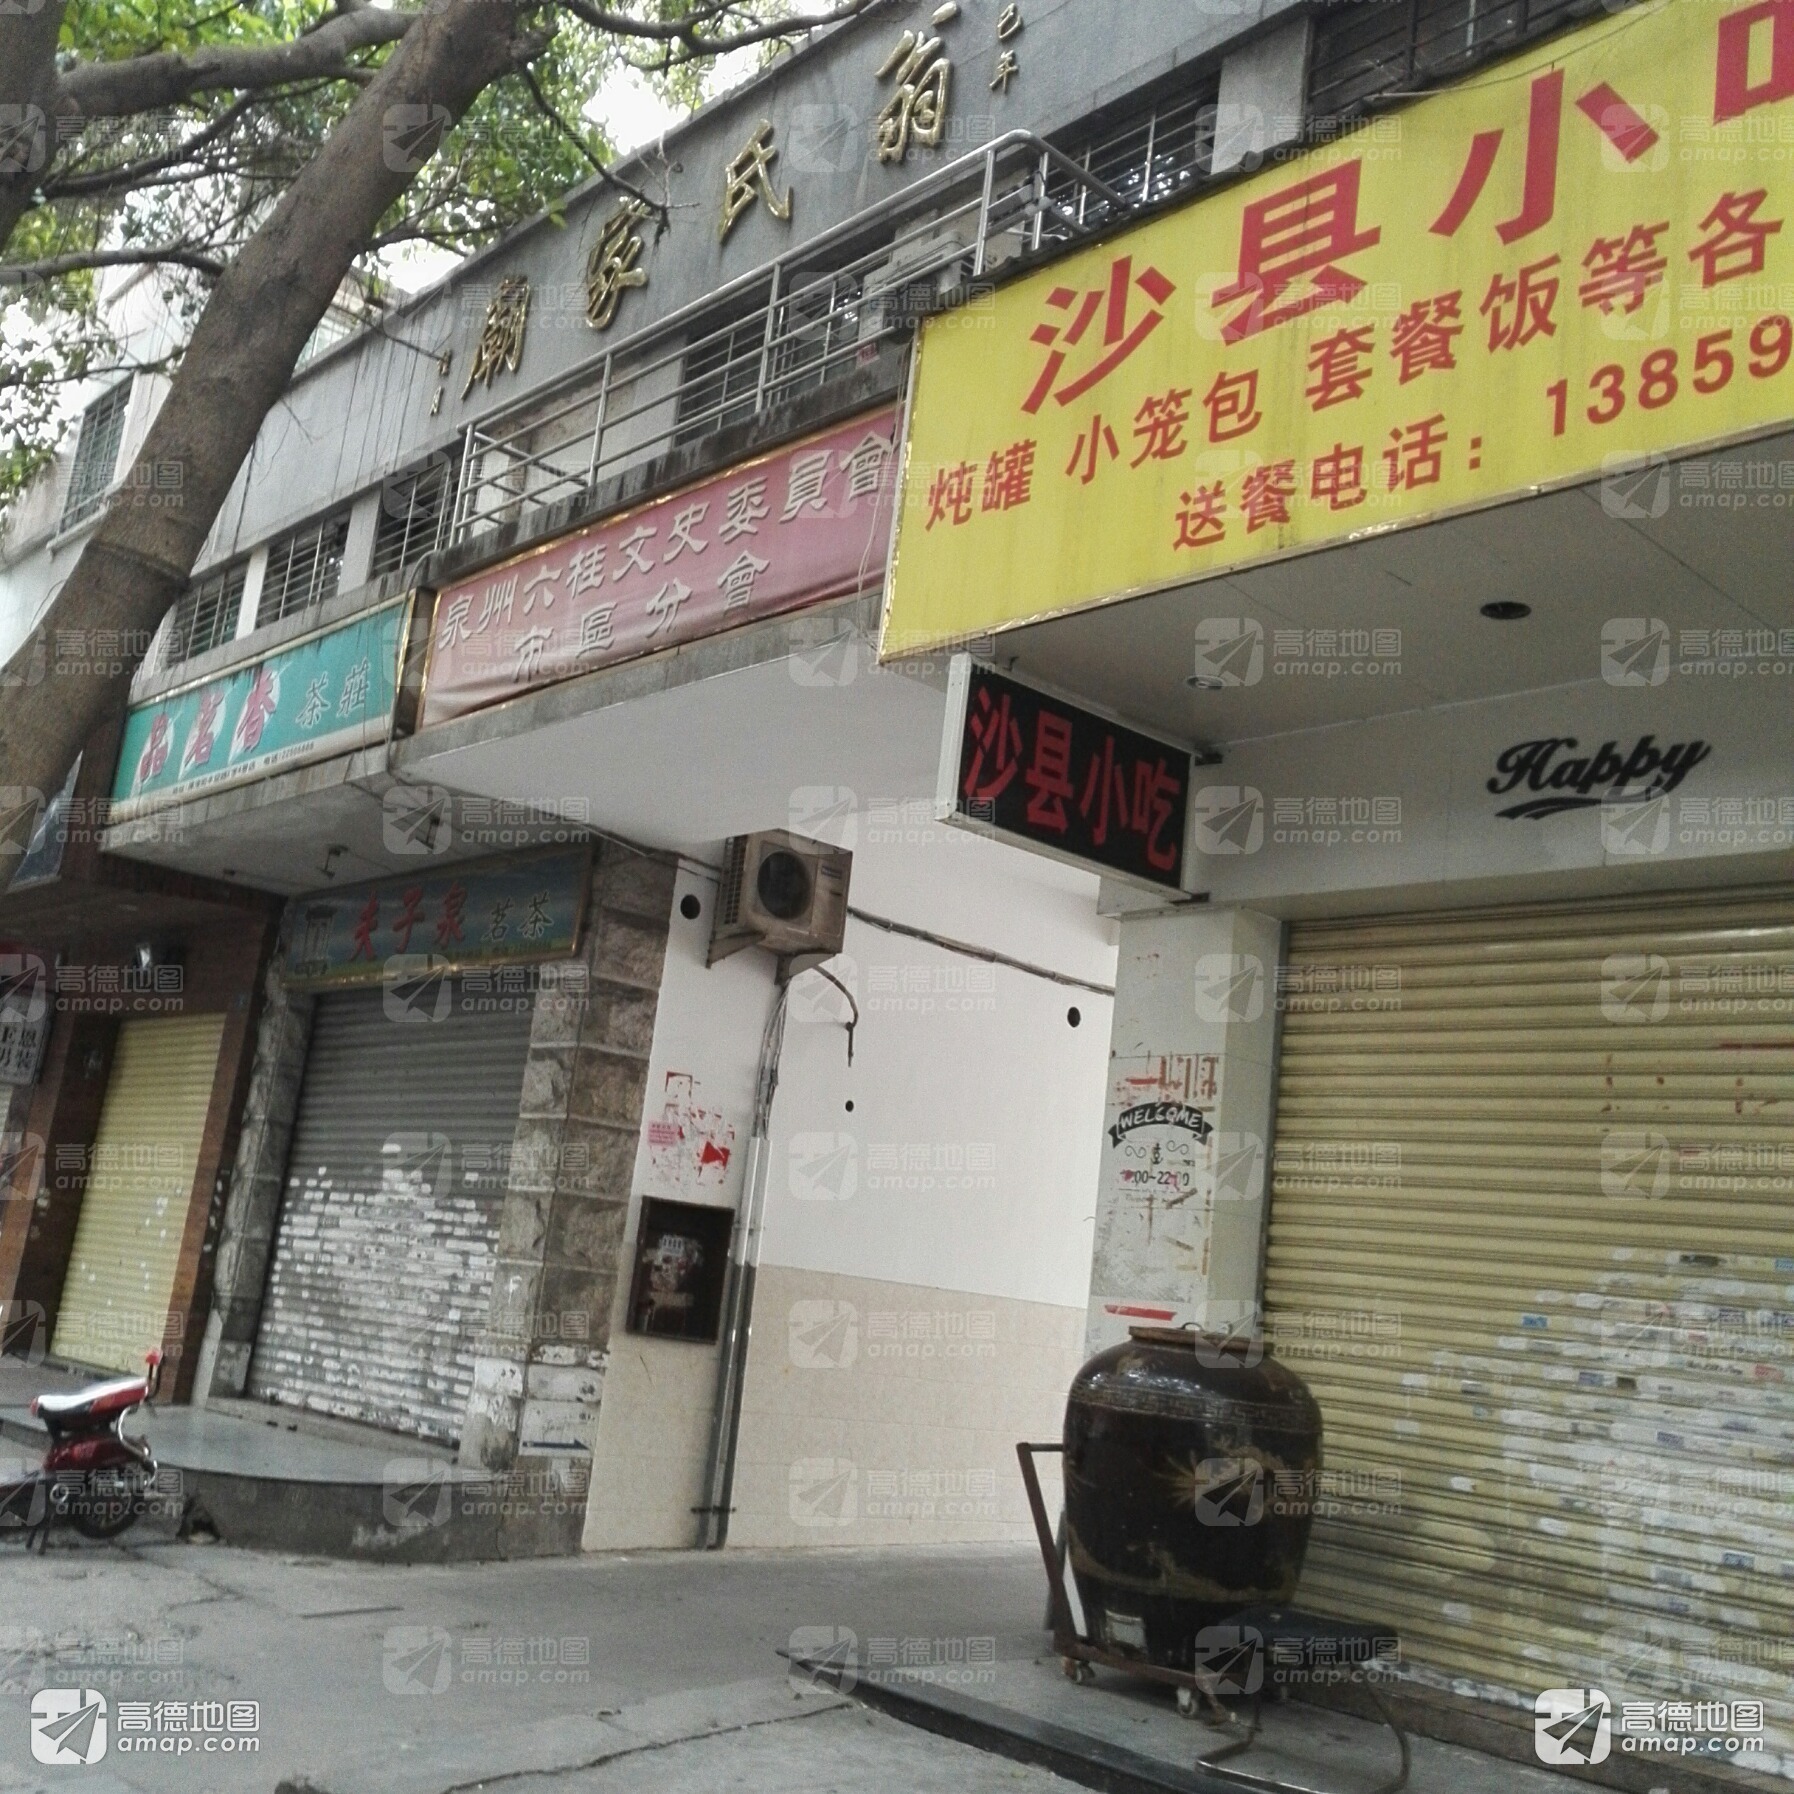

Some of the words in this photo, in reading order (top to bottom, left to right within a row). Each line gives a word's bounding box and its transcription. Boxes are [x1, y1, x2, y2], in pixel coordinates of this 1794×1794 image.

[925, 438, 1037, 531] 炖罐
[1065, 369, 1263, 485] 小笼包
[1305, 188, 1785, 413] 套餐饭等各
[1546, 314, 1793, 437] 13859
[963, 684, 1182, 872] 沙县小吃
[1486, 735, 1712, 804] Happy
[1119, 1103, 1203, 1130] WELCOME
